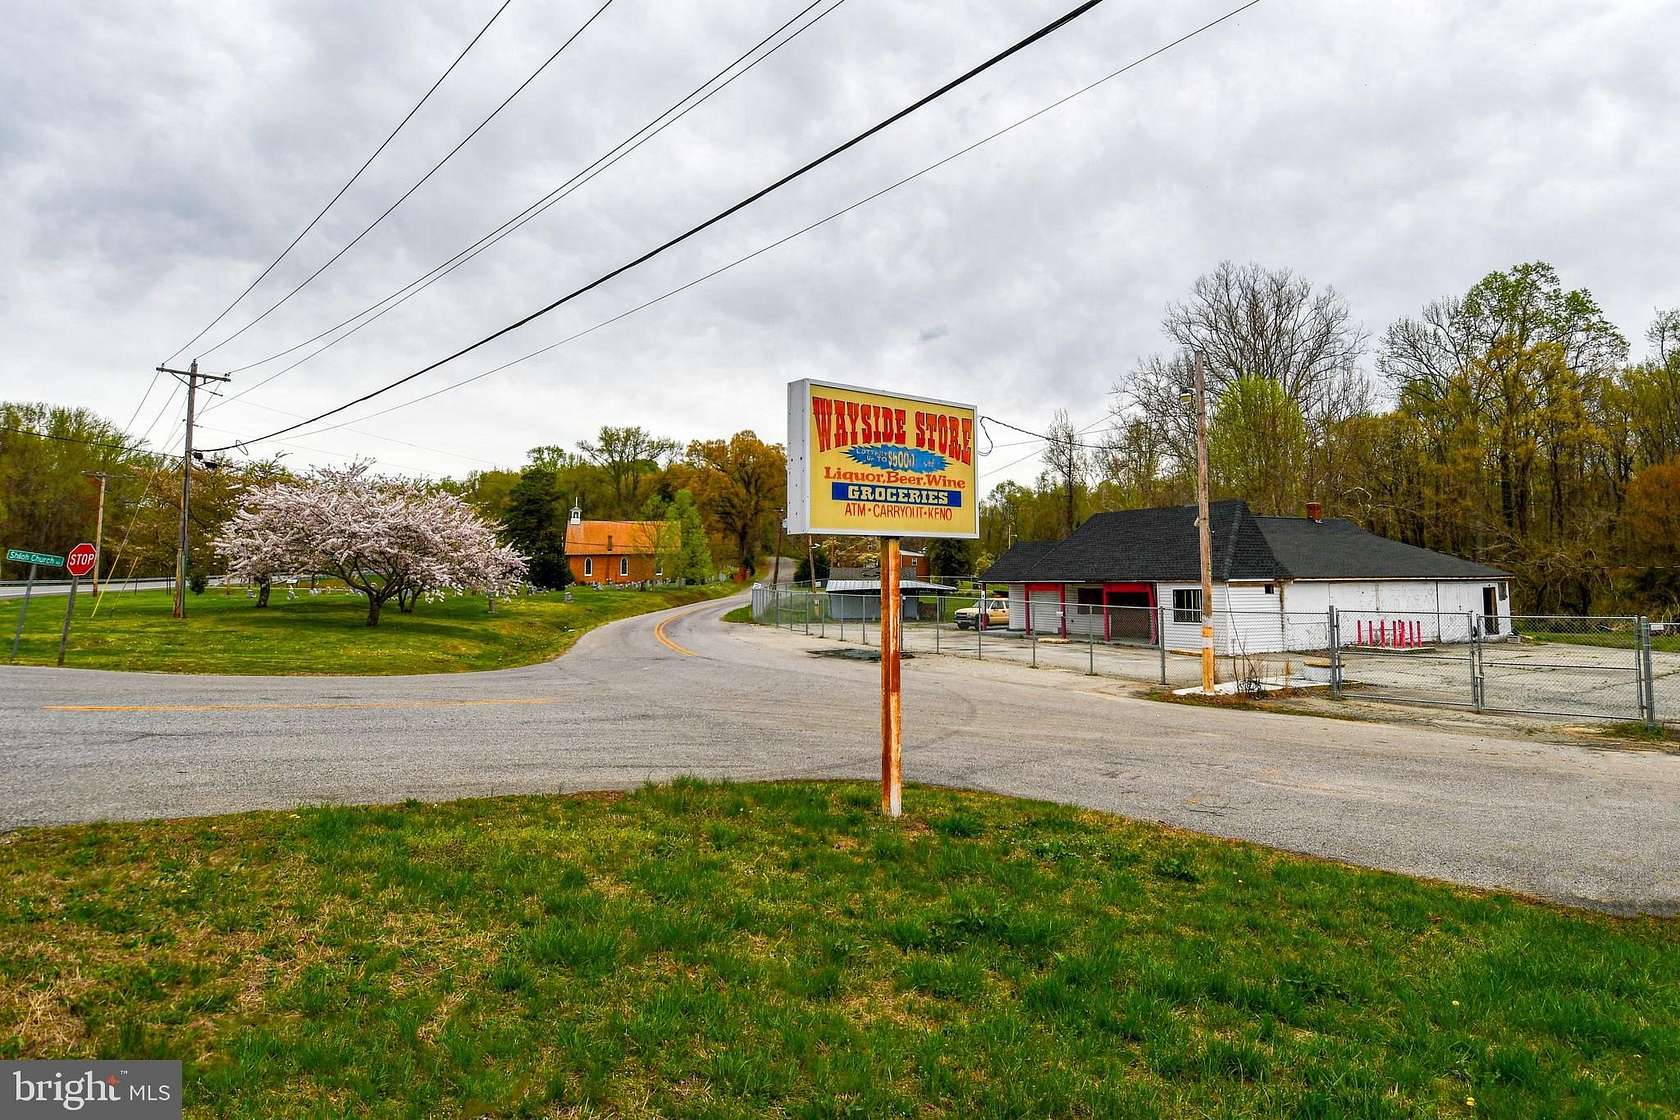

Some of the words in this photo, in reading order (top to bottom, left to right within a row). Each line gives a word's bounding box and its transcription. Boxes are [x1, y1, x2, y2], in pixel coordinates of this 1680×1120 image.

[812, 396, 906, 452] WAYSIDE
[915, 411, 972, 466] STORE
[847, 485, 949, 505] GROCERIES
[845, 502, 866, 517] ATM
[9, 551, 30, 561] Shiloh
[30, 554, 55, 565] Church
[69, 553, 95, 566] STOP
